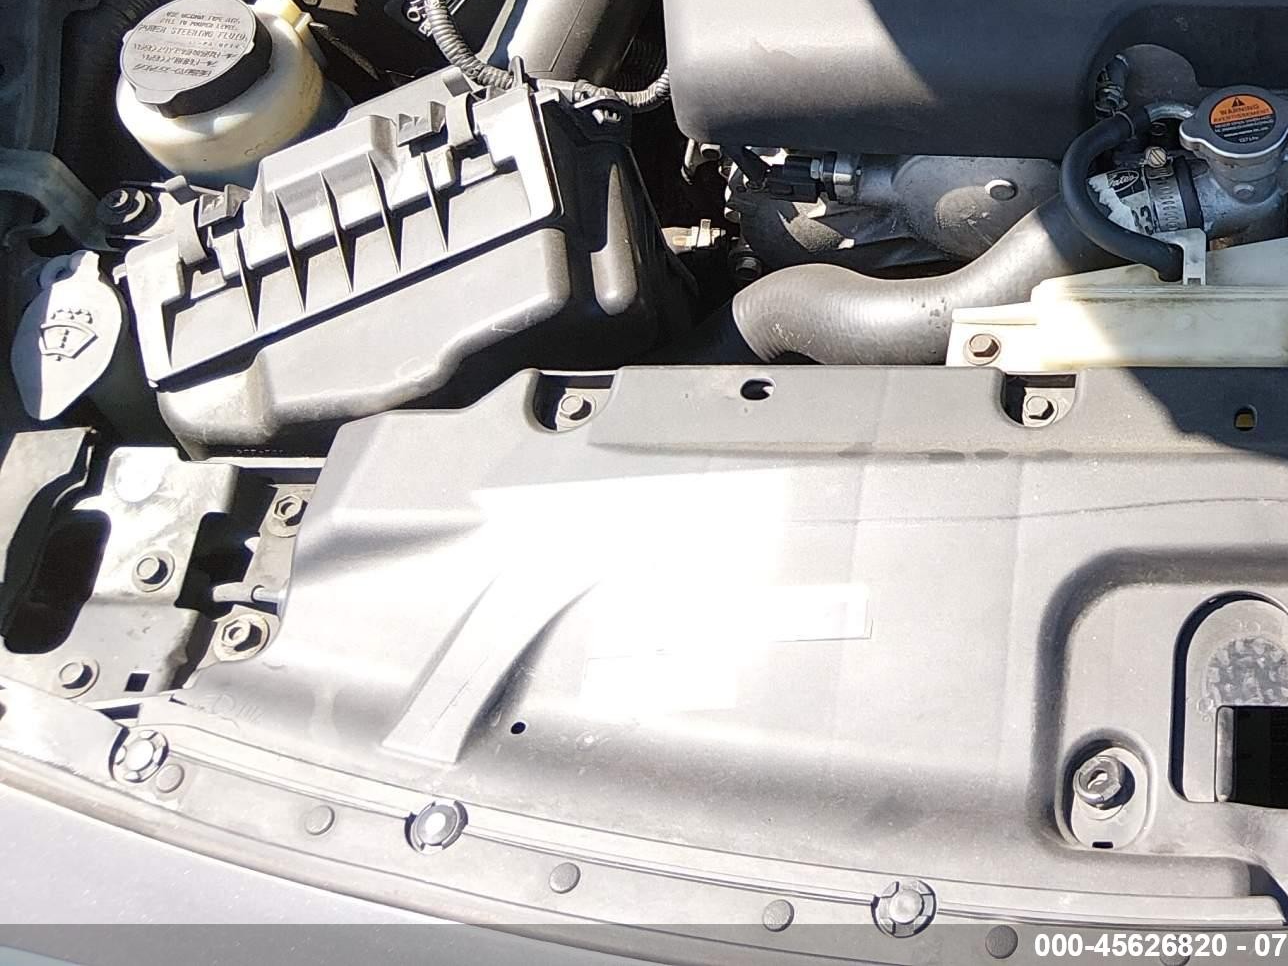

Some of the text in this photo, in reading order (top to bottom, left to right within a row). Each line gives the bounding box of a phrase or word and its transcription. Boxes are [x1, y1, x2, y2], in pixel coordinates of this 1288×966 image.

[138, 24, 167, 34] POWER
[171, 26, 213, 38] STEERING
[1220, 103, 1260, 115] WARNING
